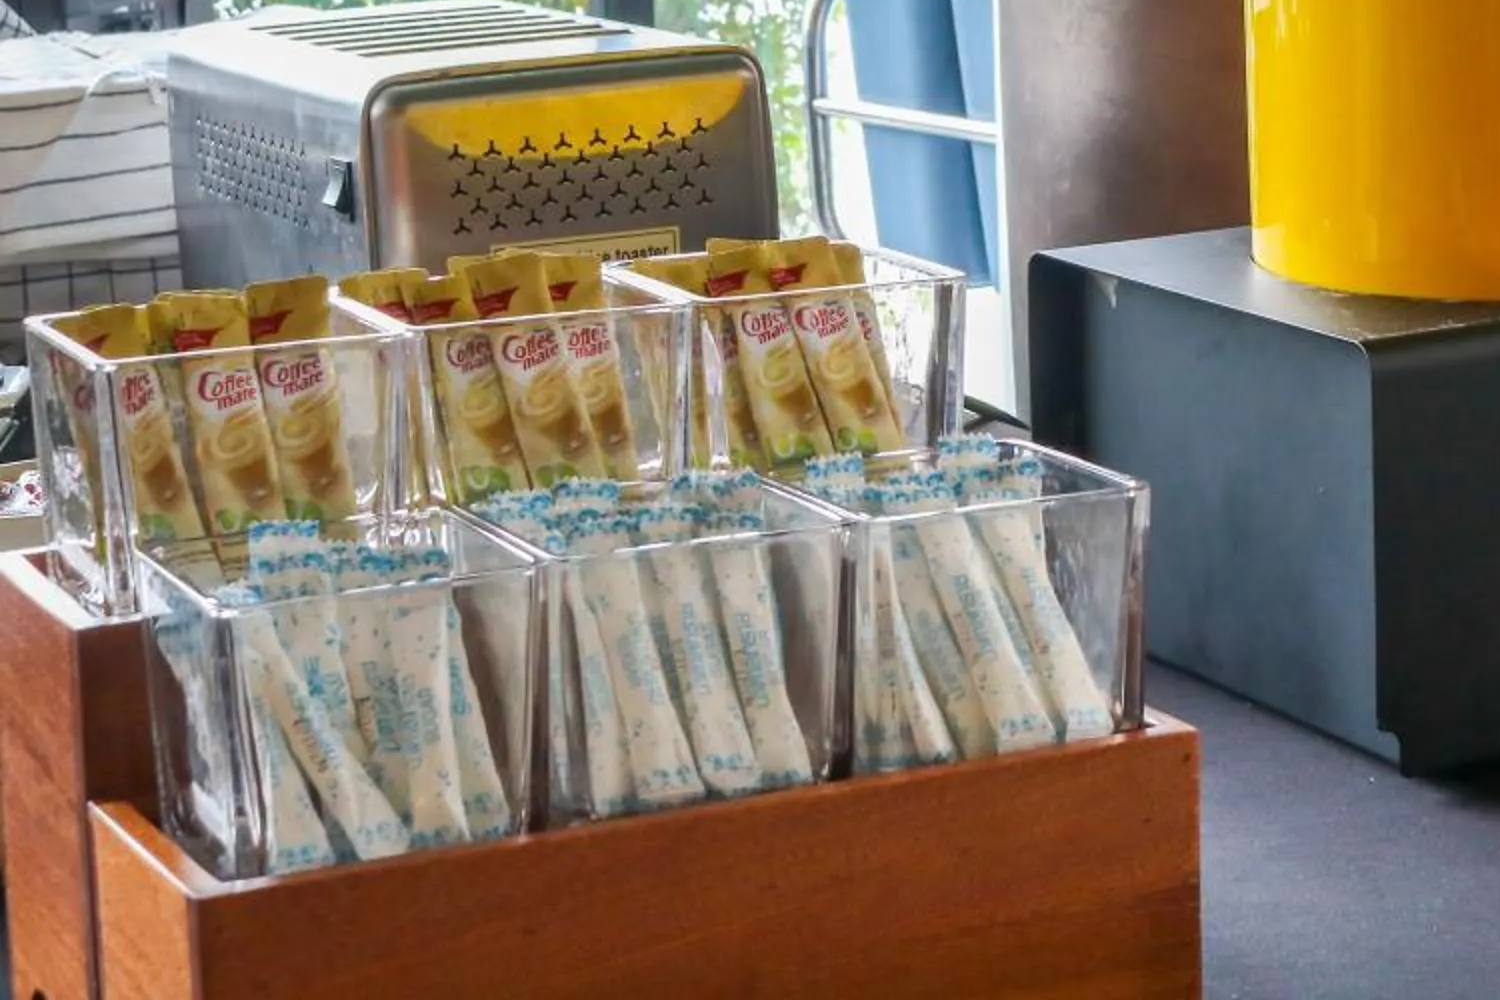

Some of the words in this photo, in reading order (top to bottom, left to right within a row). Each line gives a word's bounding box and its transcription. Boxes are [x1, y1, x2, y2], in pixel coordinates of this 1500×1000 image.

[568, 326, 609, 348] offee
[817, 315, 849, 338] mate
[502, 331, 557, 364] Coffee
[522, 343, 559, 371] mate
[199, 371, 253, 401] Coffee
[263, 358, 321, 388] Coffee
[283, 370, 324, 397] mate
[217, 386, 257, 411] mate
